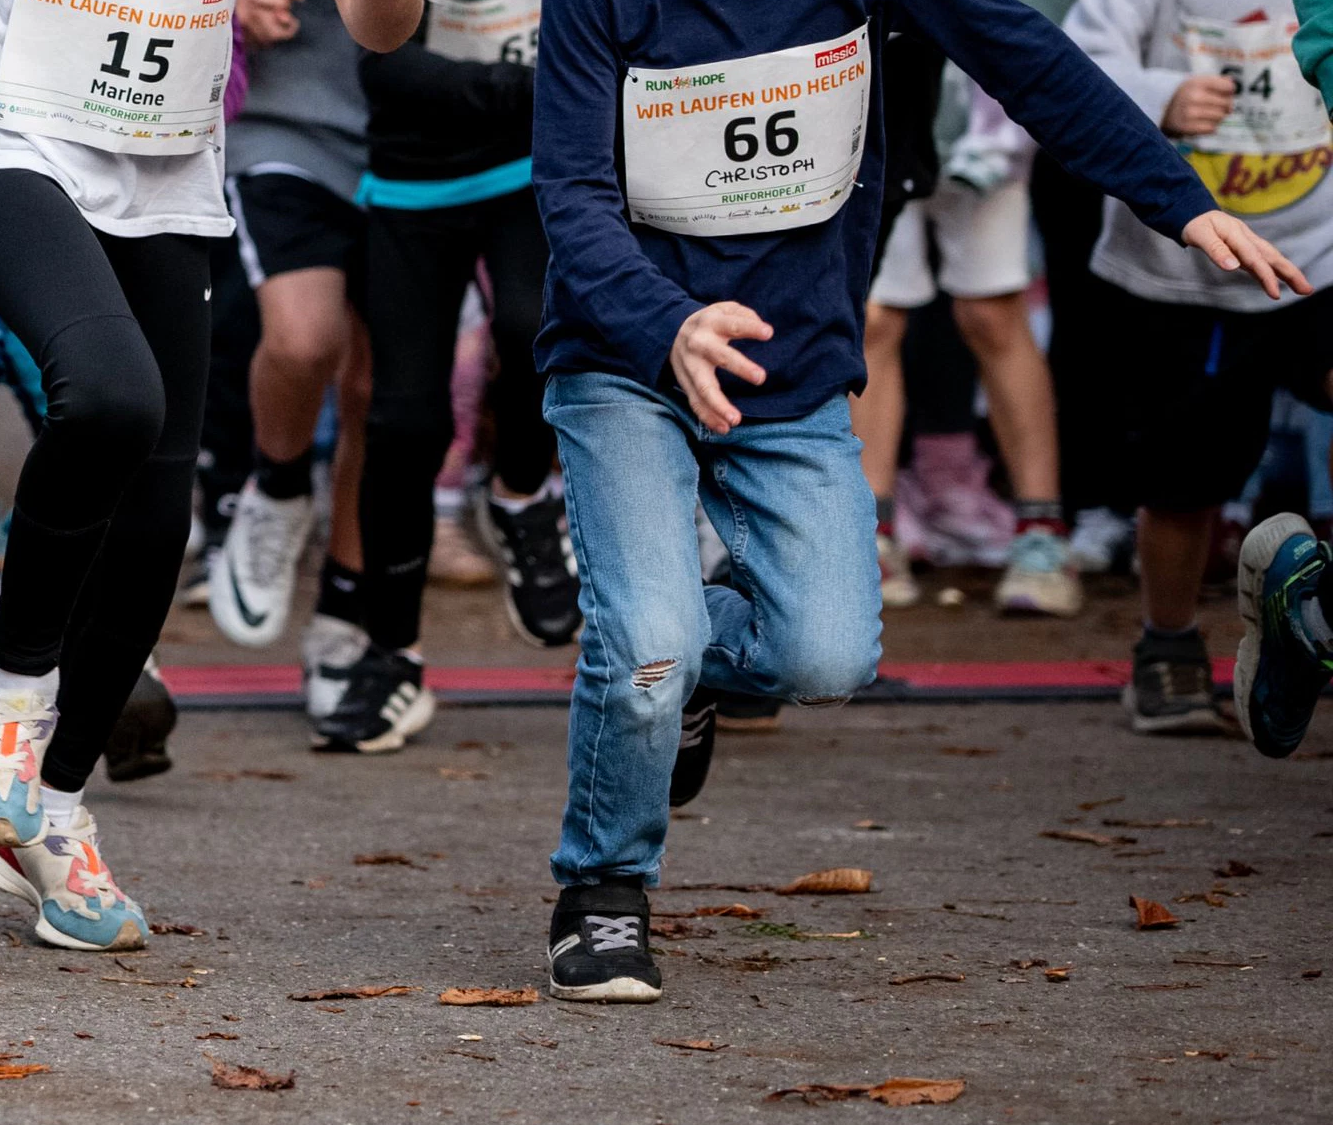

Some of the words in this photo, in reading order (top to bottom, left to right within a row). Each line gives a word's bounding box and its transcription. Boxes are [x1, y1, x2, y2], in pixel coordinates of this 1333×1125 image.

[148, 11, 186, 30] UND
[100, 31, 174, 83] 15
[816, 45, 857, 67] missio
[90, 78, 165, 106] Marlene
[636, 102, 674, 119] WIR
[681, 92, 754, 114] LAUFEN
[761, 83, 802, 103] UND
[807, 61, 865, 94] HELFEN
[645, 80, 672, 91] RUN
[693, 73, 725, 86] HOPE
[84, 101, 162, 122] RUNFORHOPE.AT
[724, 110, 800, 162] 66
[705, 158, 815, 187] CHRISTOPH
[721, 184, 807, 203] RUNFORHOPE.AT
